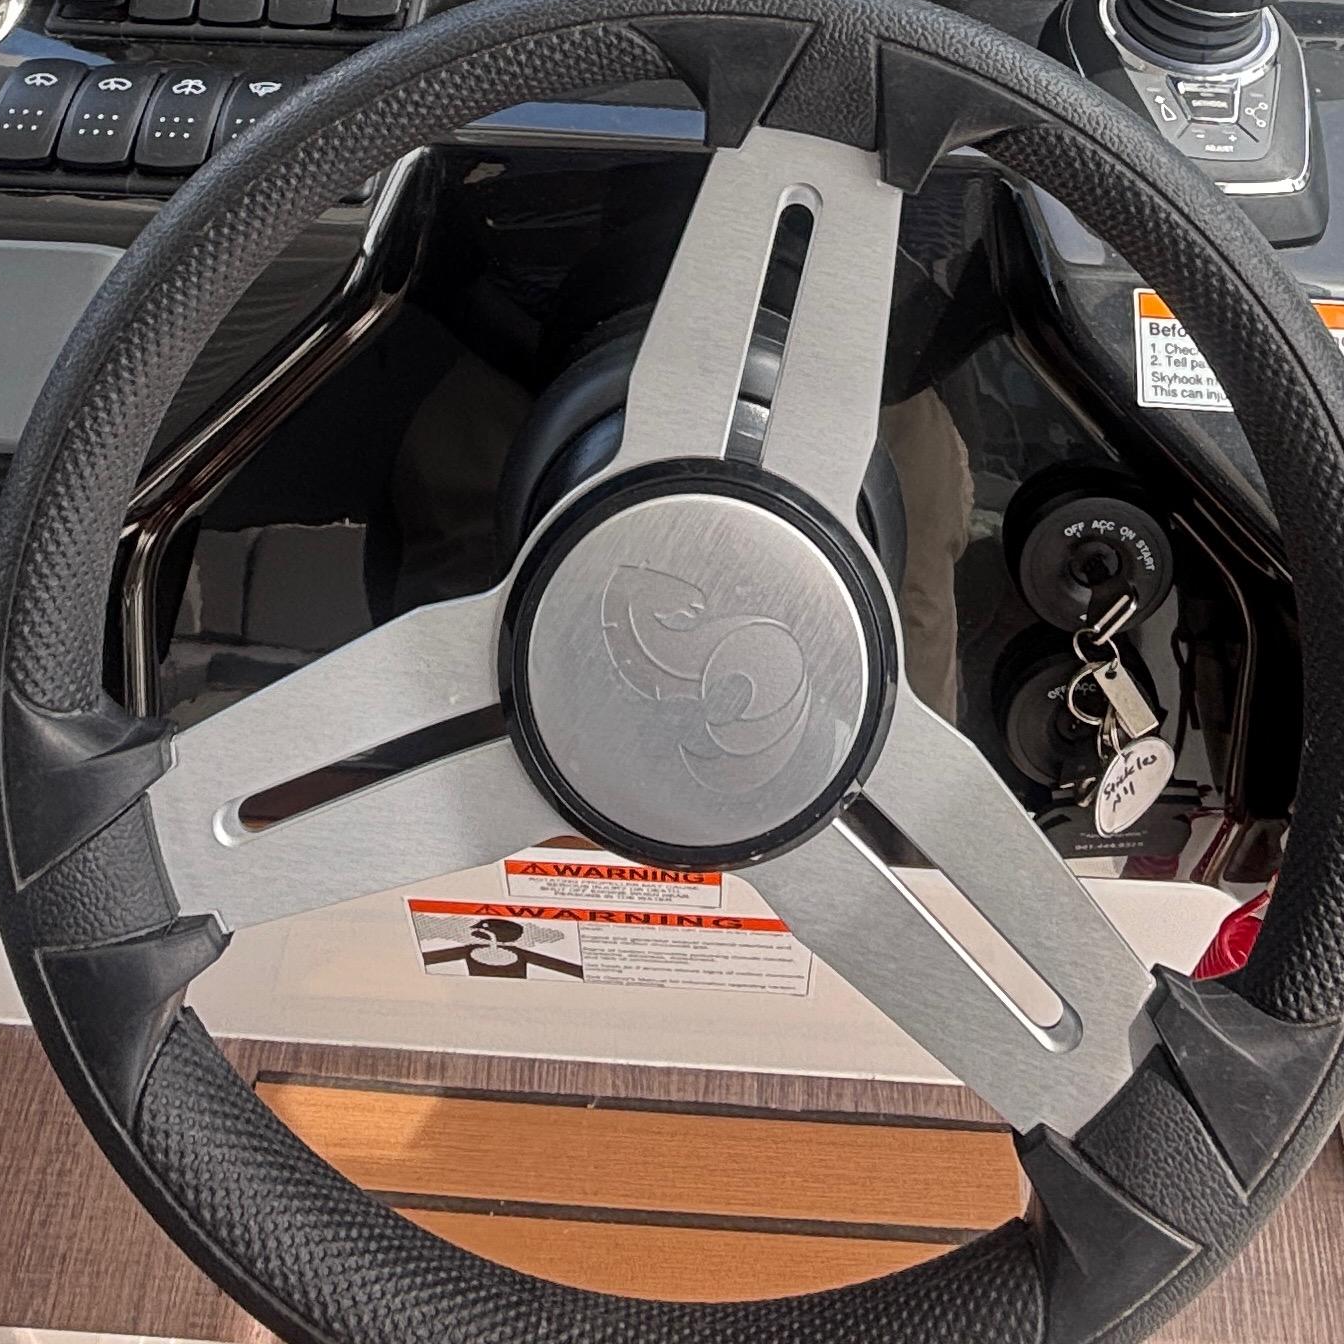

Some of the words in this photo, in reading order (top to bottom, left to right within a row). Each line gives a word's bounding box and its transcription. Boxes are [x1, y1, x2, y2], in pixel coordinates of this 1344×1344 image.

[1149, 322, 1188, 338] Befo
[1164, 343, 1200, 356] Chec
[1150, 355, 1163, 367] 2.
[1166, 356, 1188, 368] Tell
[1151, 372, 1203, 387] Skyhook
[1151, 385, 1178, 398] This
[1181, 389, 1204, 399] can
[1206, 389, 1228, 403] inju
[1064, 520, 1086, 537] OFF
[1091, 519, 1115, 532] ACC
[1119, 526, 1136, 541] ON
[1135, 539, 1155, 573] START
[552, 864, 706, 884] WARNING
[506, 905, 744, 930] WARNING
